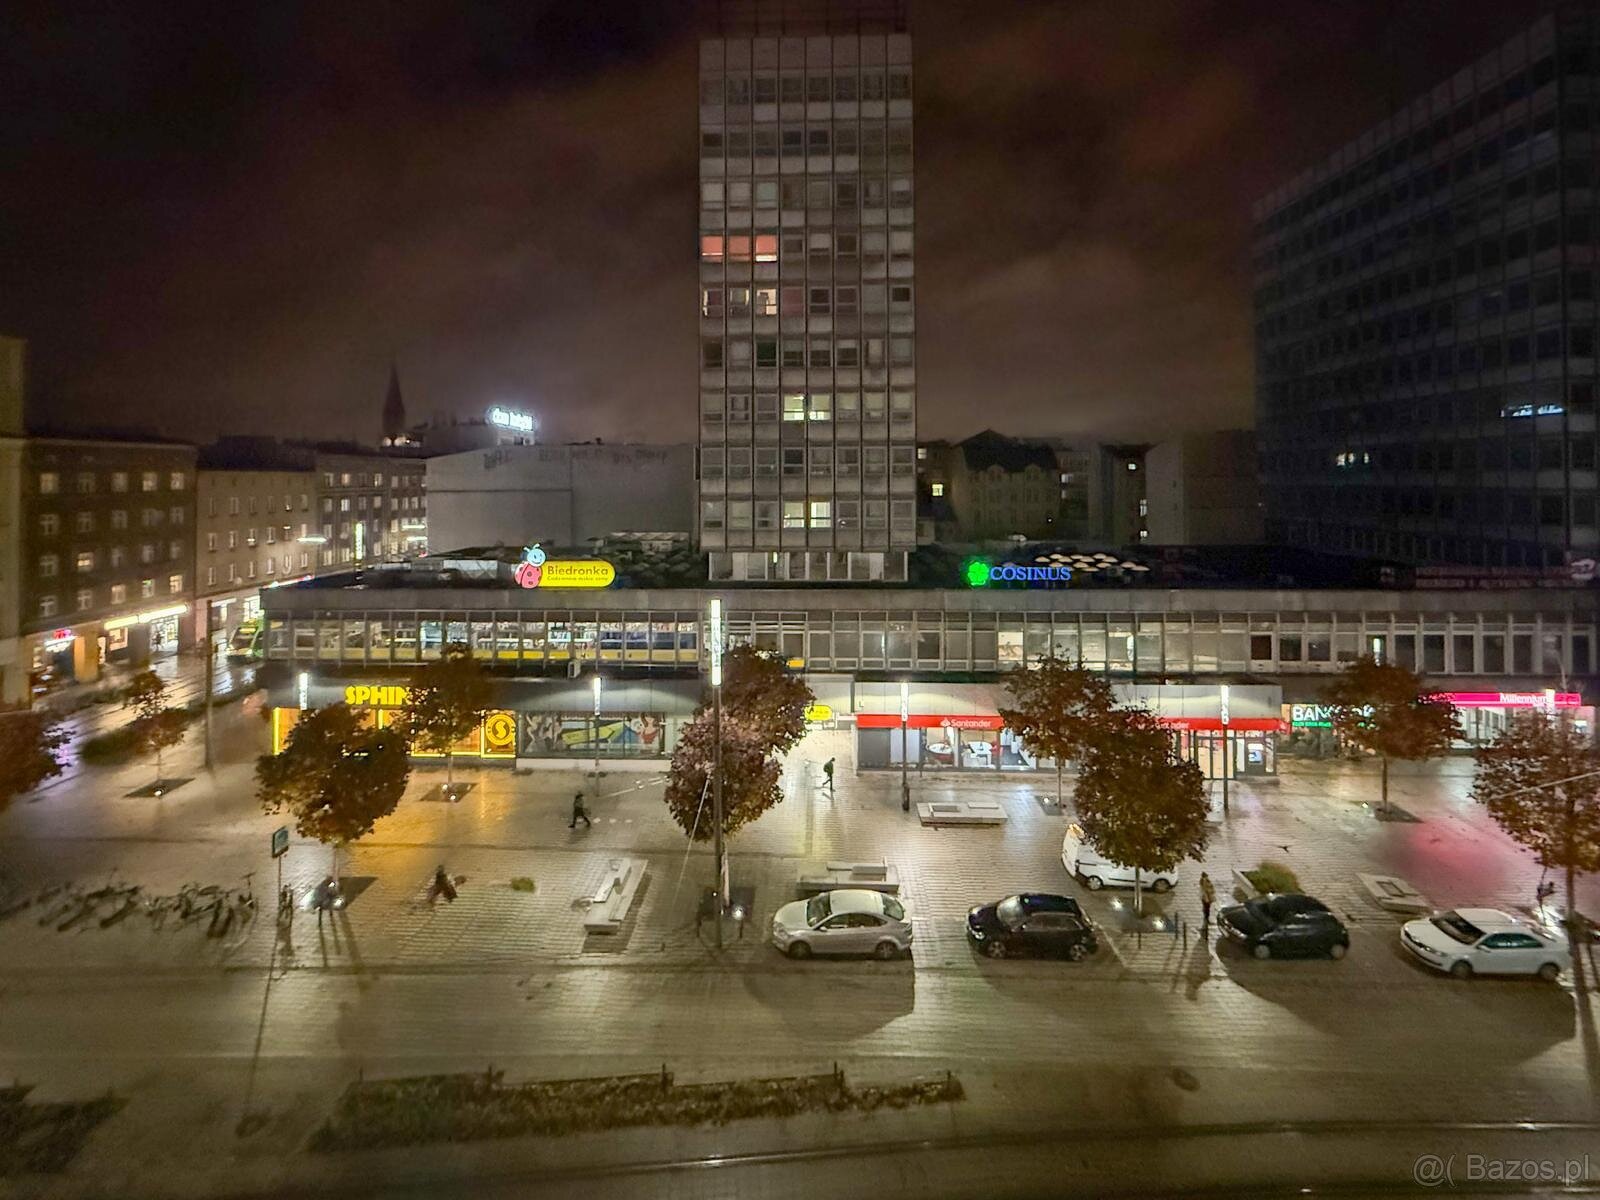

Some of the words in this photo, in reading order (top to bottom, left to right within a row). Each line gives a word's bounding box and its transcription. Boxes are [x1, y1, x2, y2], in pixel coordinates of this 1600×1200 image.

[548, 566, 608, 575] Biedronka
[990, 566, 1072, 581] COSINUS
[951, 719, 991, 727] Santander
